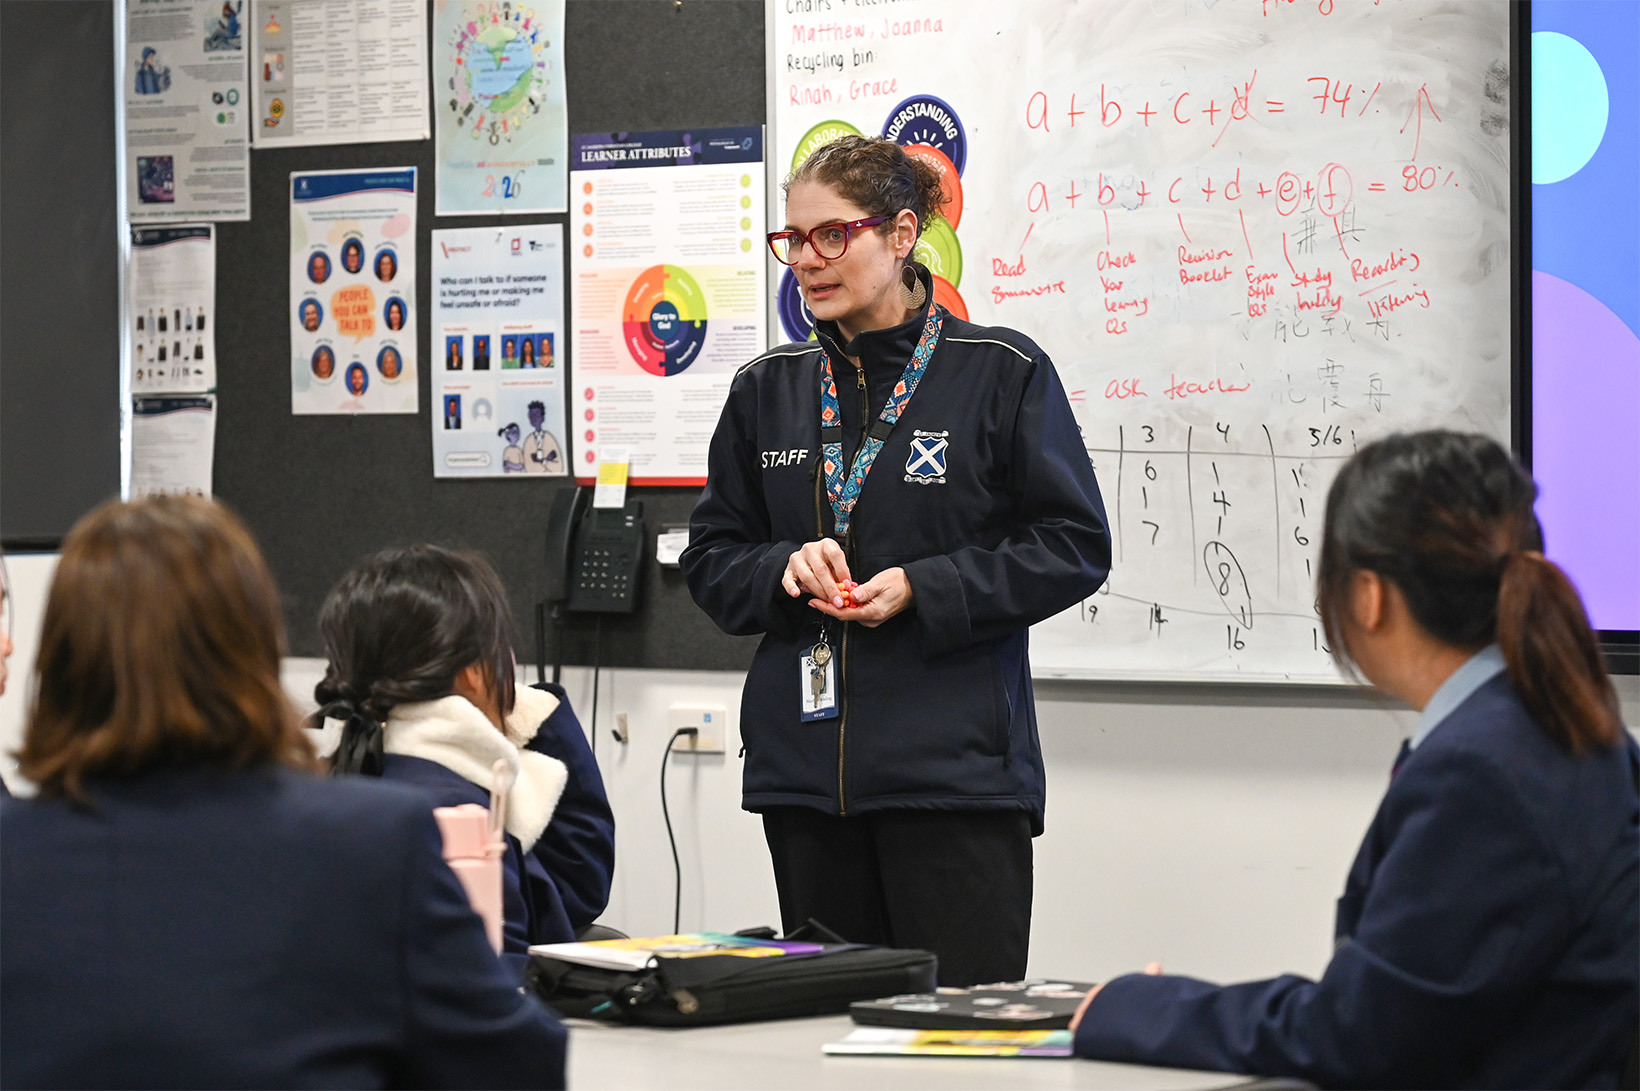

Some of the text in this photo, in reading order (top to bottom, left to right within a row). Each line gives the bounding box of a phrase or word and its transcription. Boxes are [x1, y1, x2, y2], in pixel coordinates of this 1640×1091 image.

[880, 17, 944, 40] Joanna
[787, 53, 844, 75] Recycling
[849, 77, 899, 101] Grace
[1027, 91, 1050, 132] a
[1101, 84, 1122, 127] b
[1308, 77, 1381, 118] 74%
[884, 102, 958, 142] NDERSTANDING
[581, 146, 692, 163] LEARNER ATTRIBUTES
[1028, 180, 1049, 213] a
[1099, 172, 1115, 205] b
[1224, 167, 1242, 201] d
[1280, 180, 1298, 202] e
[1324, 165, 1344, 210] f
[992, 254, 1027, 277] Read
[1097, 250, 1137, 271] Check
[1178, 245, 1233, 265] Revision
[1351, 248, 1420, 283] Recording
[440, 276, 457, 285] Who
[458, 277, 473, 285] can
[479, 276, 493, 284] talk
[495, 275, 504, 284] to
[505, 274, 511, 283] if
[512, 275, 547, 283] someone
[1179, 266, 1233, 285] Booklet
[339, 289, 369, 303] PEOPLE
[440, 290, 446, 298] is
[447, 288, 476, 299] hurting
[491, 288, 500, 296] or
[501, 286, 530, 296] making
[440, 300, 453, 309] feel
[455, 299, 481, 308] unsafe
[492, 297, 520, 307] afraid?
[335, 303, 369, 317] YOU CAN
[340, 318, 373, 331] TALK TO
[1104, 378, 1148, 400] ask
[1163, 373, 1251, 402] teacher
[1141, 425, 1155, 443] 3
[1216, 421, 1231, 443] 4
[761, 448, 809, 469] STAFF
[1145, 460, 1157, 480] 6
[1213, 490, 1232, 516] 4
[1142, 520, 1159, 546] 7
[1294, 526, 1309, 547] 6
[1217, 562, 1231, 597] 8
[1226, 624, 1246, 651] 16
